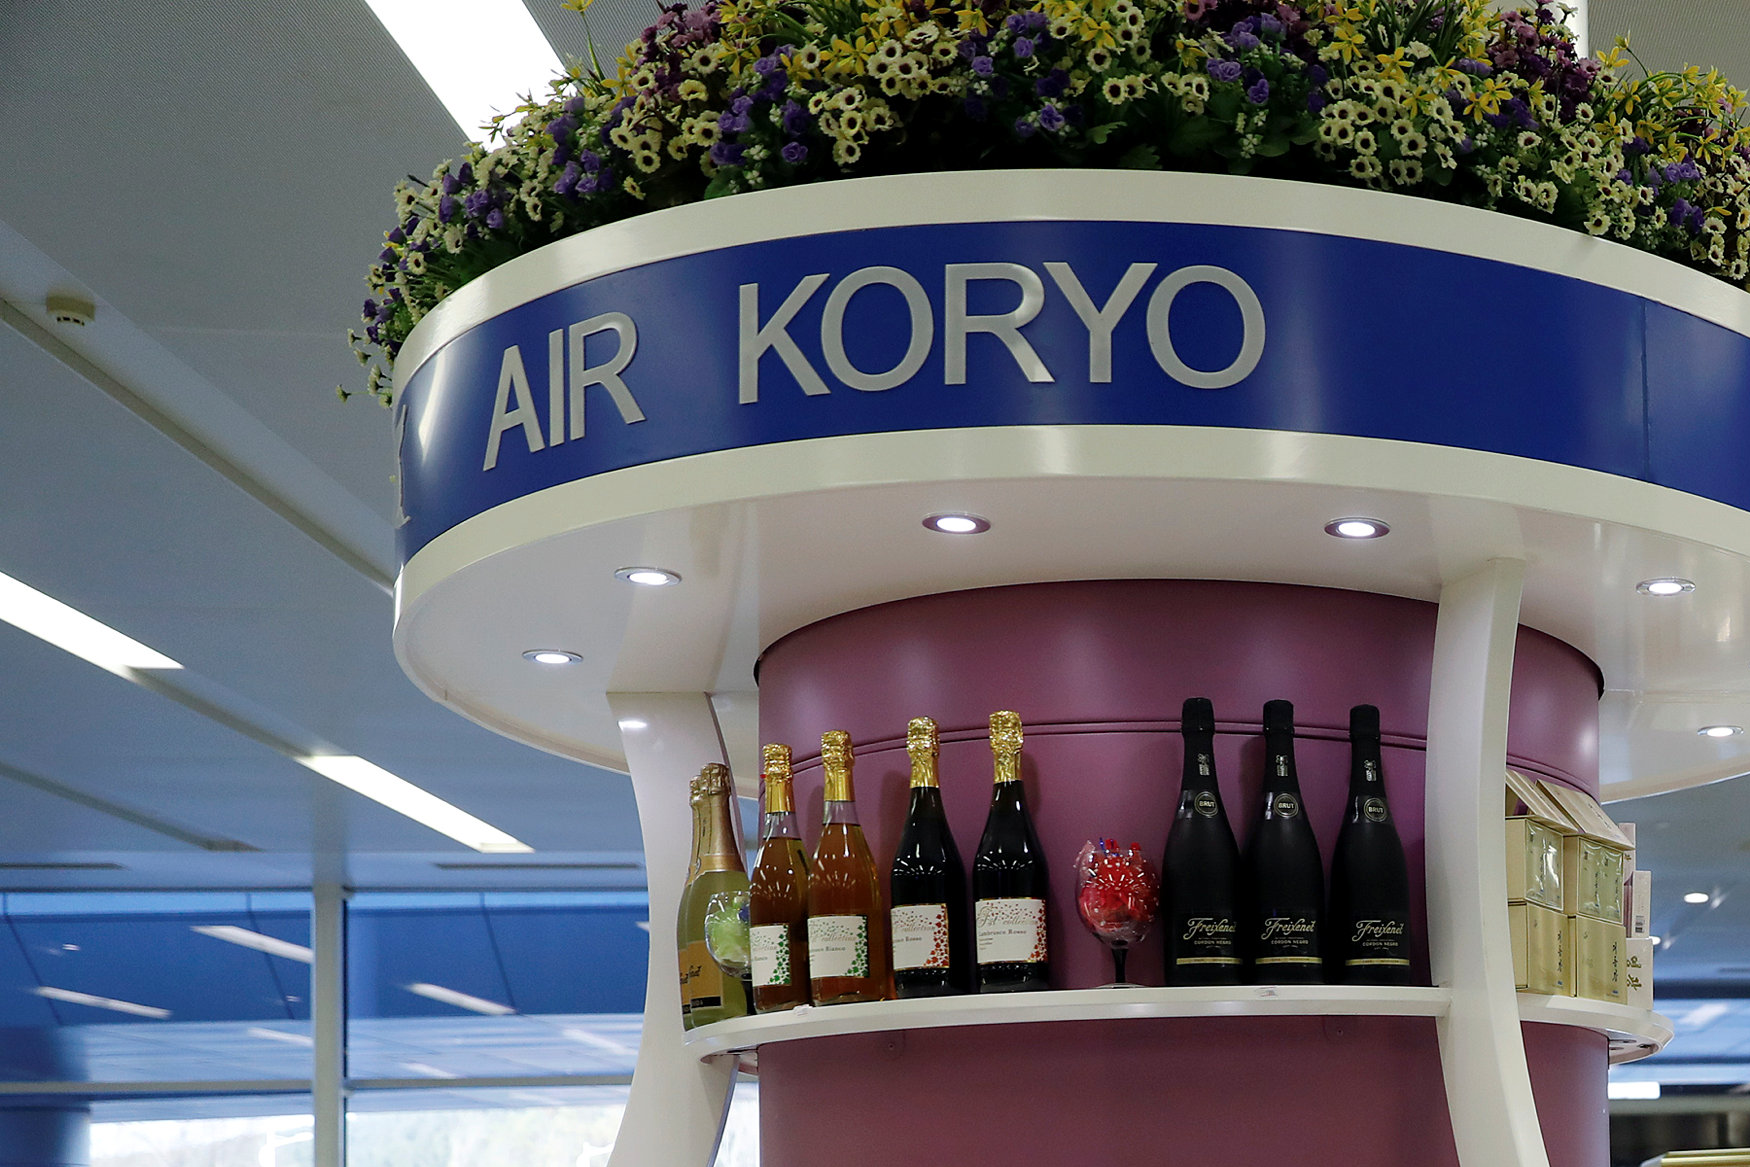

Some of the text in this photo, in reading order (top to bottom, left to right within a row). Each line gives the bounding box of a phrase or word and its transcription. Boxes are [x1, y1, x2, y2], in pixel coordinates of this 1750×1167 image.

[482, 262, 1266, 472] AIR KORYO
[1183, 917, 1236, 940] Freixenet
[1261, 917, 1316, 940] Freixenet
[1351, 919, 1405, 942] Freixenet
